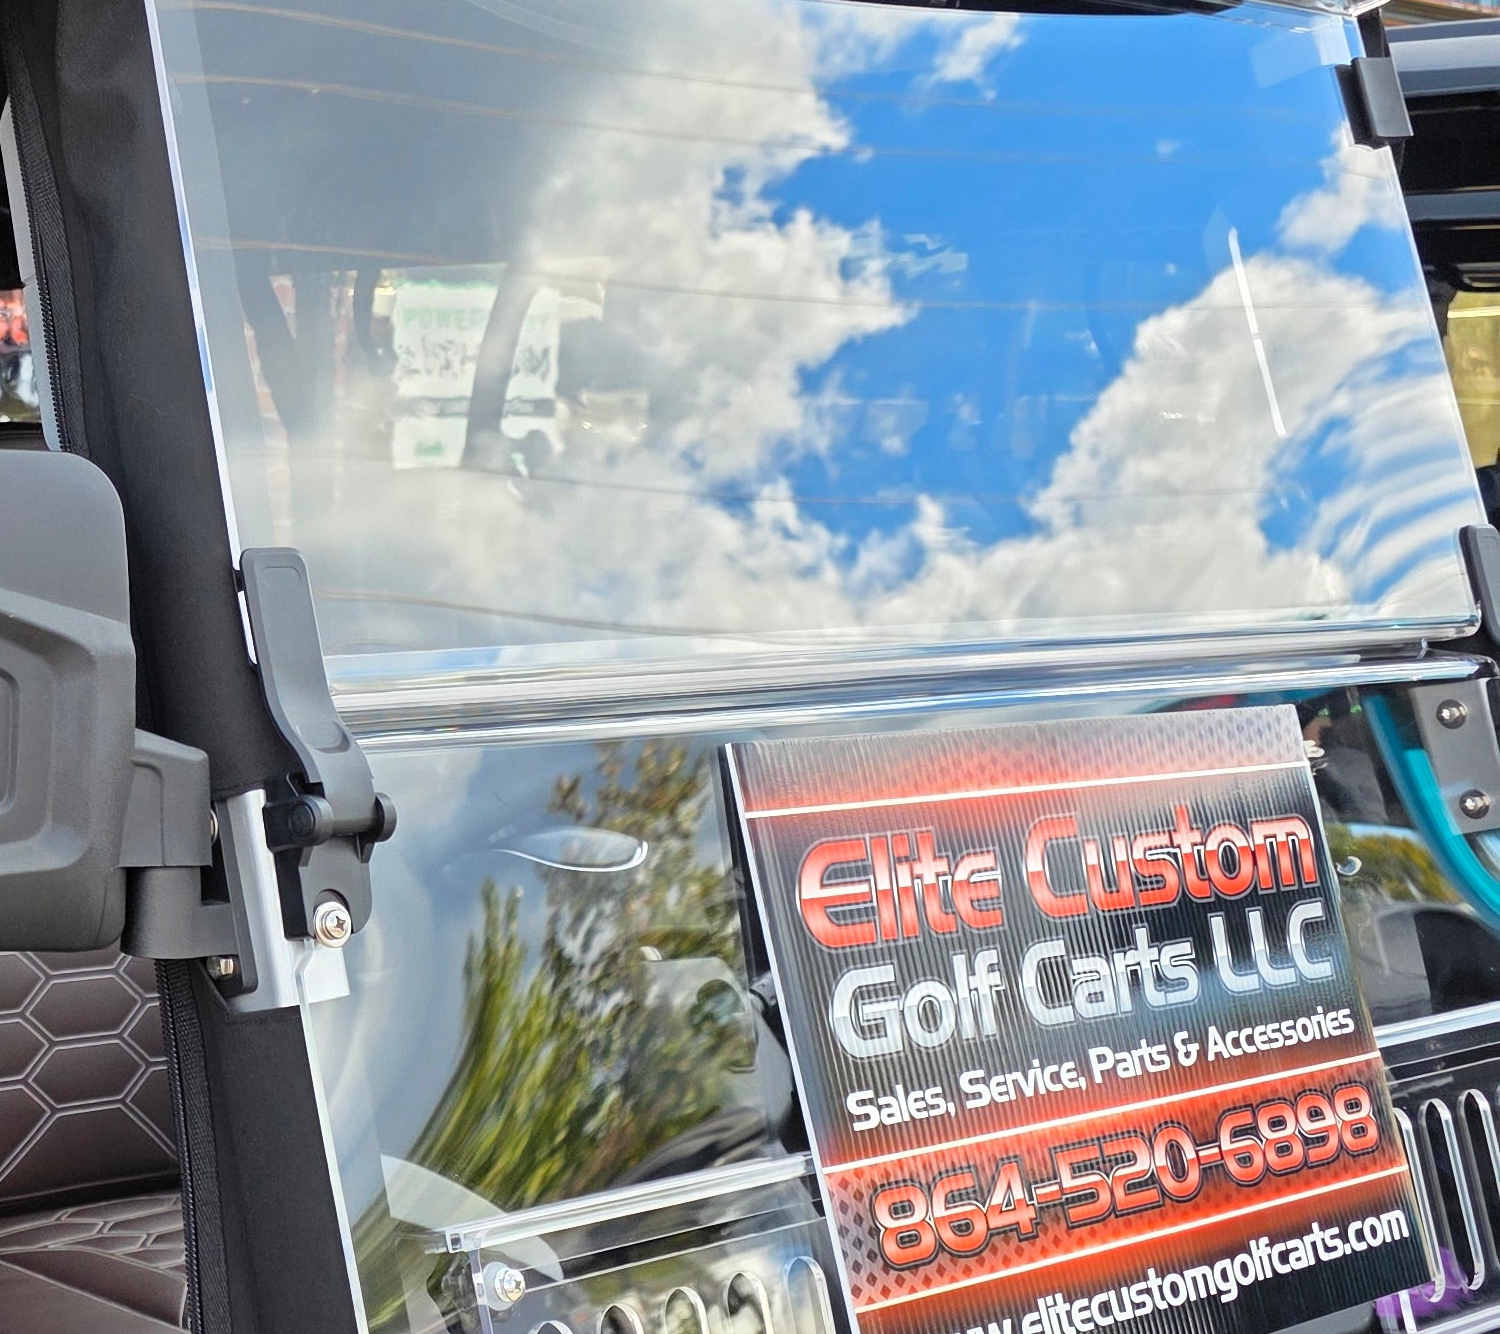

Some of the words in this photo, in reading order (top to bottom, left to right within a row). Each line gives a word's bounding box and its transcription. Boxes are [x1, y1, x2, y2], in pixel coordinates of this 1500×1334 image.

[797, 828, 1004, 950] Elite
[1025, 804, 1320, 920] Custom
[830, 948, 1003, 1059] Golf
[1020, 925, 1200, 1027] Carts
[1210, 901, 1334, 994] LLC
[846, 1085, 956, 1132] Sales,
[959, 1059, 1086, 1110] Service,
[1092, 1039, 1167, 1084] Parts
[1176, 1030, 1200, 1066] &
[1206, 1007, 1355, 1062] Accessories
[871, 1086, 1380, 1268] 864-520-6898
